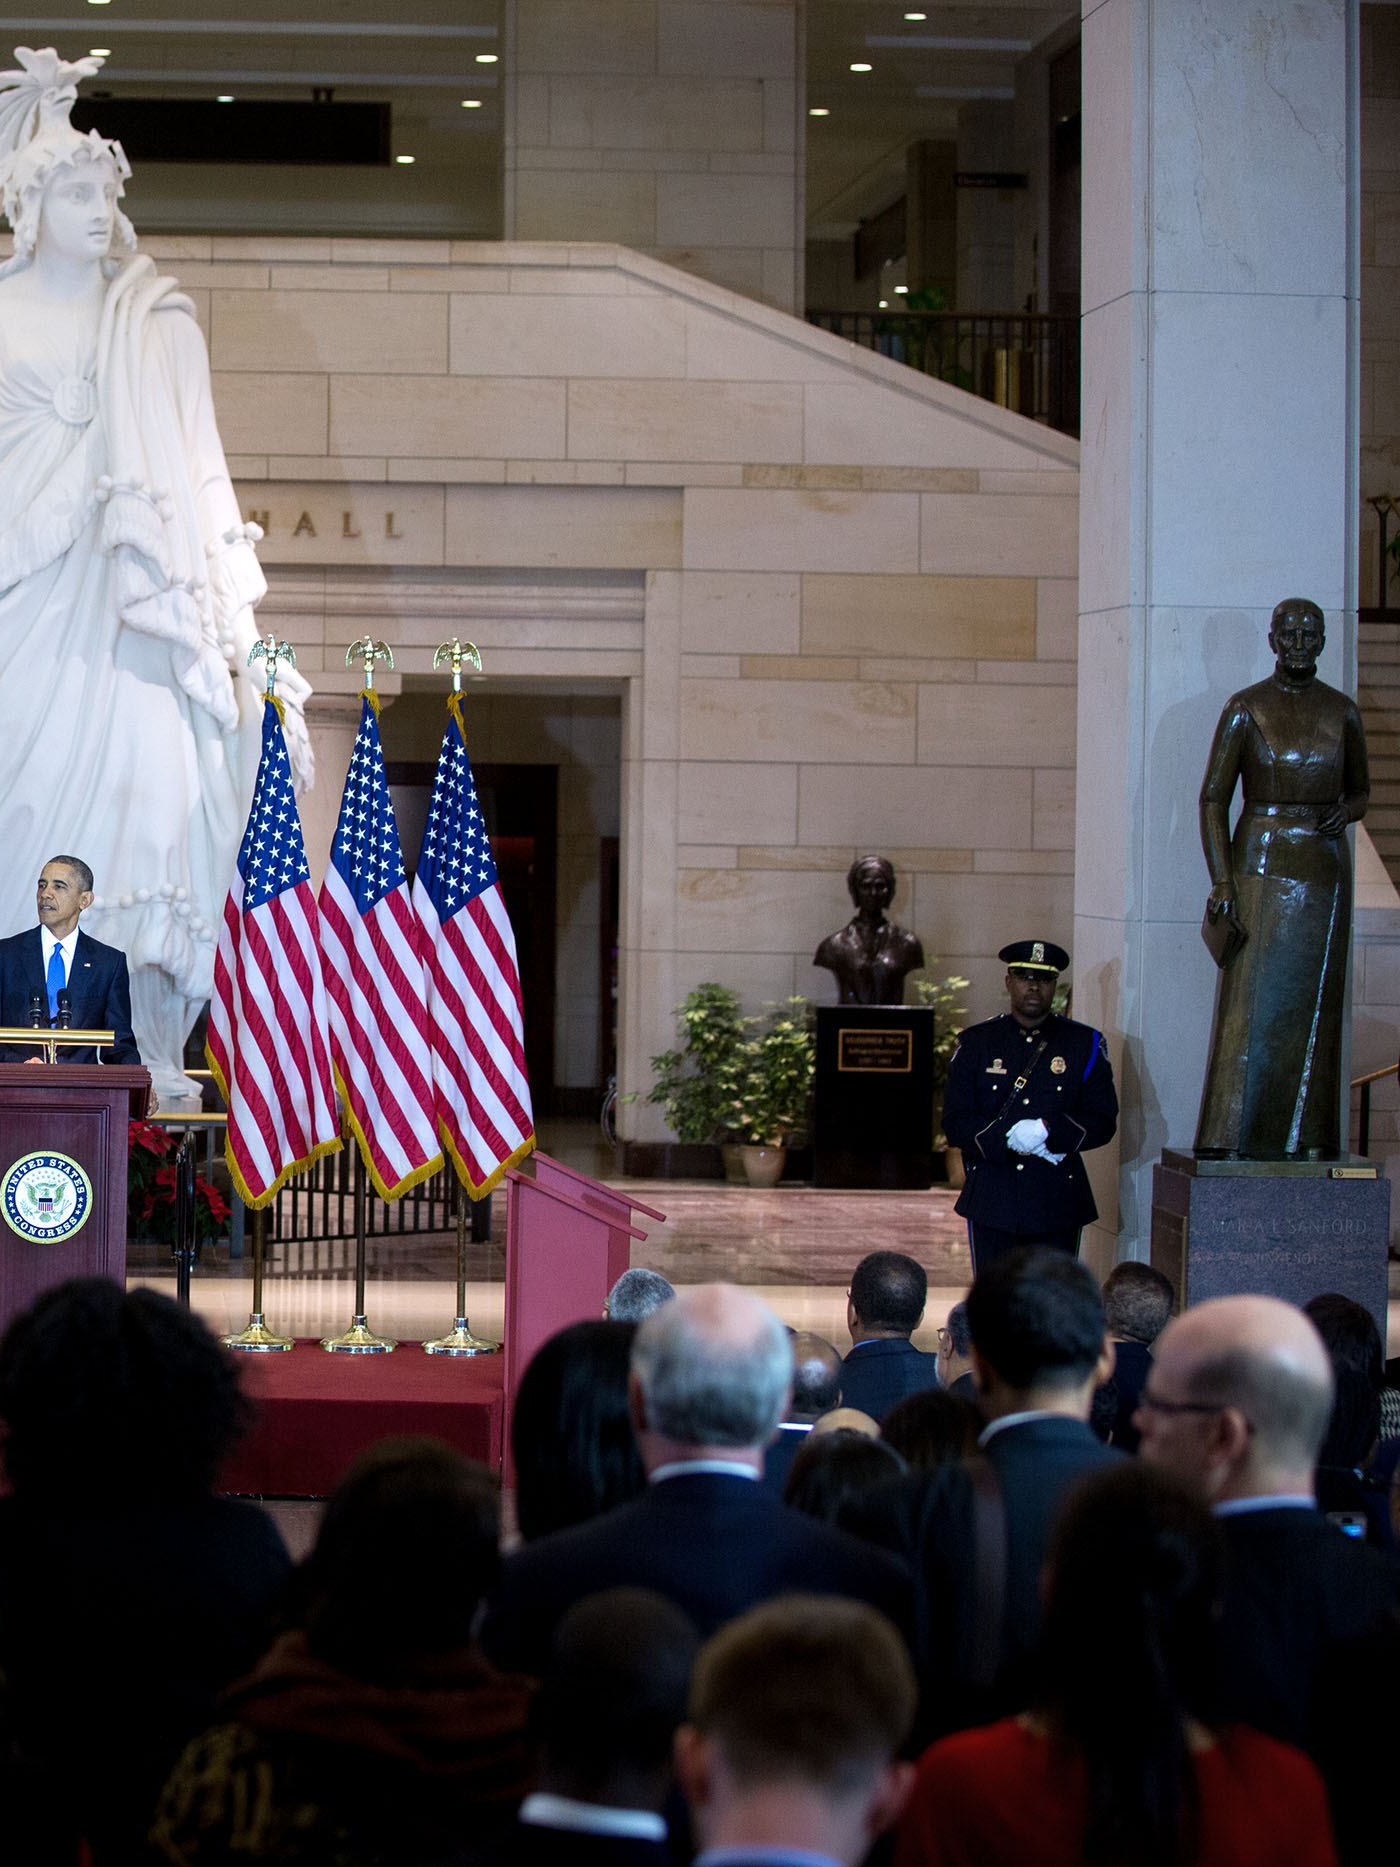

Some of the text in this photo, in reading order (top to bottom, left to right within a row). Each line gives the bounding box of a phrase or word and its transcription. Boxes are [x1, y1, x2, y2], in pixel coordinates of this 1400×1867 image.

[247, 509, 403, 539] HALL
[7, 1158, 85, 1194] UNITED STATES
[14, 1216, 78, 1237] CONGRESS
[1287, 1218, 1368, 1235] SANFORD
